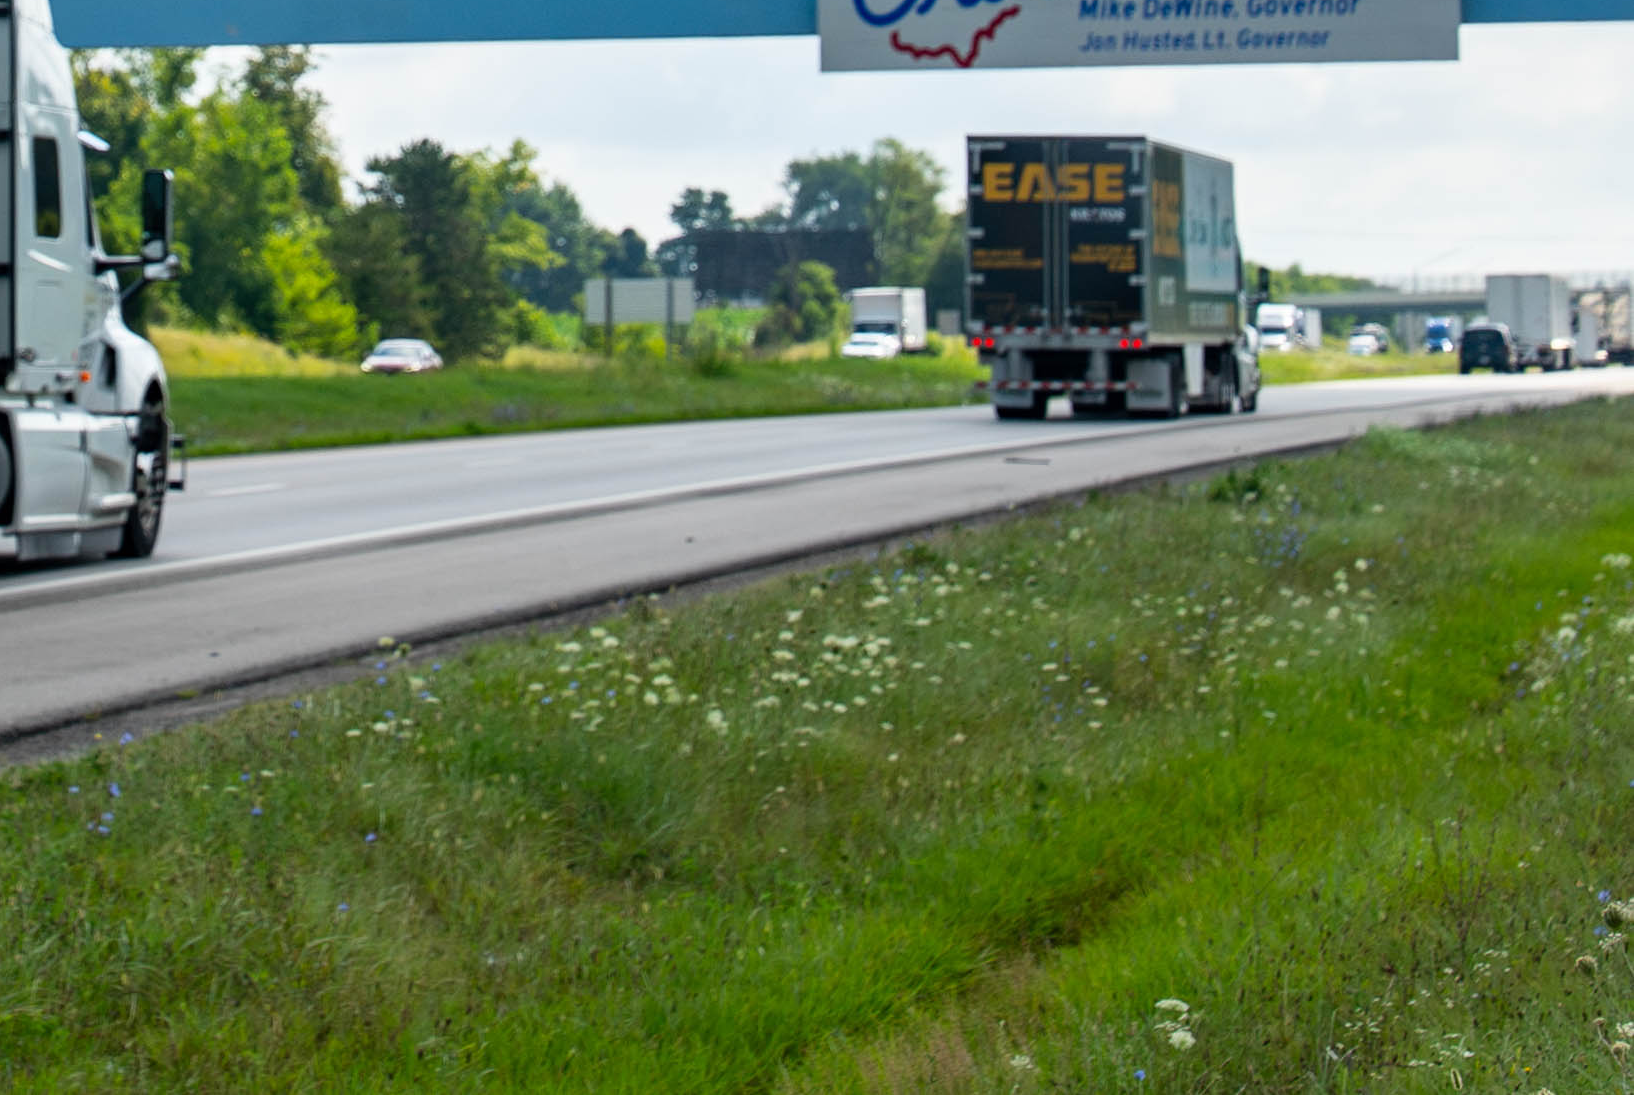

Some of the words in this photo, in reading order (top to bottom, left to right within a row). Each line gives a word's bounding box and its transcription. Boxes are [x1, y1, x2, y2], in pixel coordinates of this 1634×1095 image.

[1078, 32, 1117, 52] Jon
[1237, 27, 1331, 50] Governor
[982, 162, 1127, 203] EASE
